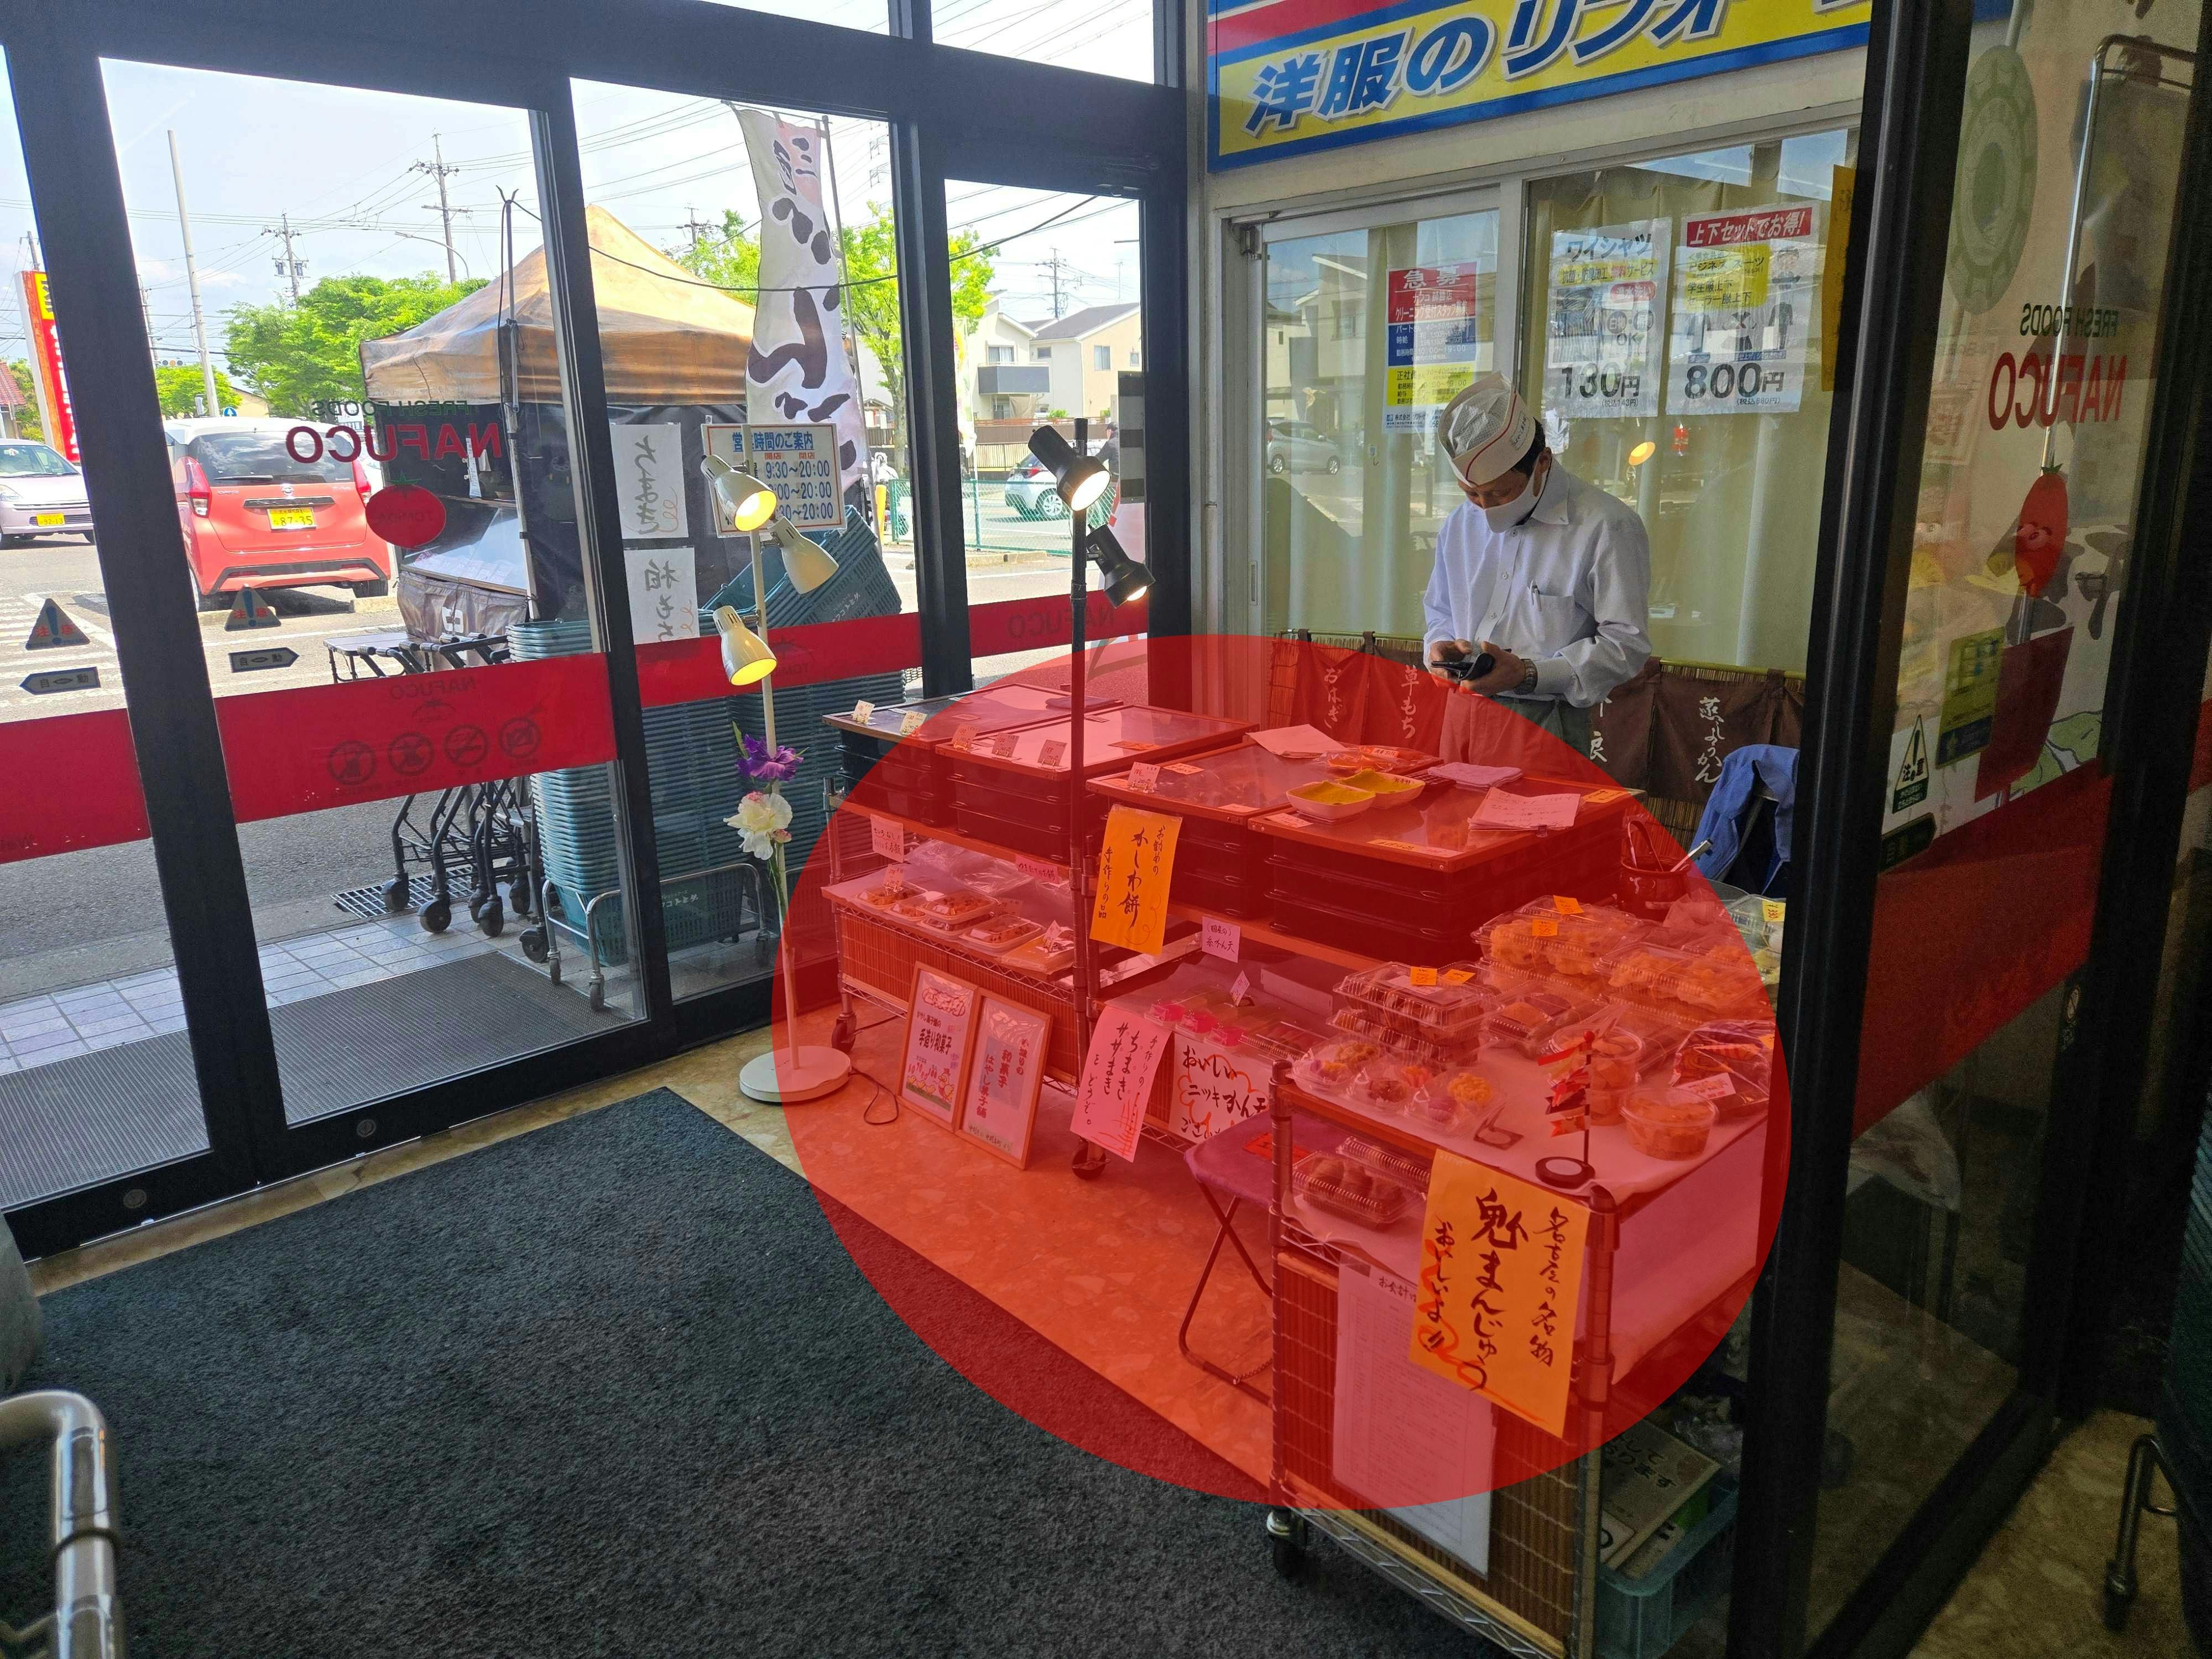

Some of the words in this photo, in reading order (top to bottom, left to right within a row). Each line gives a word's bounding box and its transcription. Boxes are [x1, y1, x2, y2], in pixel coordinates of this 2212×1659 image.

[1568, 234, 1652, 262] ワイシャツ
[1403, 265, 1460, 289] 急募
[1687, 280, 1734, 293] 学生服上下
[1562, 363, 1639, 399] 130円
[1684, 362, 1785, 399] 800円
[732, 431, 815, 451] 営時間のご案内
[280, 515, 314, 527] 87-35
[775, 502, 834, 521] :30~20:00
[39, 673, 89, 688] 自動
[1323, 666, 1343, 729] おはぎ
[1400, 664, 1420, 739] 草もち
[1098, 846, 1113, 920] 手作りの品
[1117, 827, 1149, 931] かしわ餅
[919, 1028, 952, 1055] 手造り和菓子
[1117, 1030, 1140, 1100] ちまき
[1139, 1035, 1158, 1088] 手作りの
[1182, 1045, 1238, 1079] おいしい
[1469, 1187, 1529, 1391] 鬼まんじゅう
[1530, 1206, 1569, 1368] 名古屋の名物
